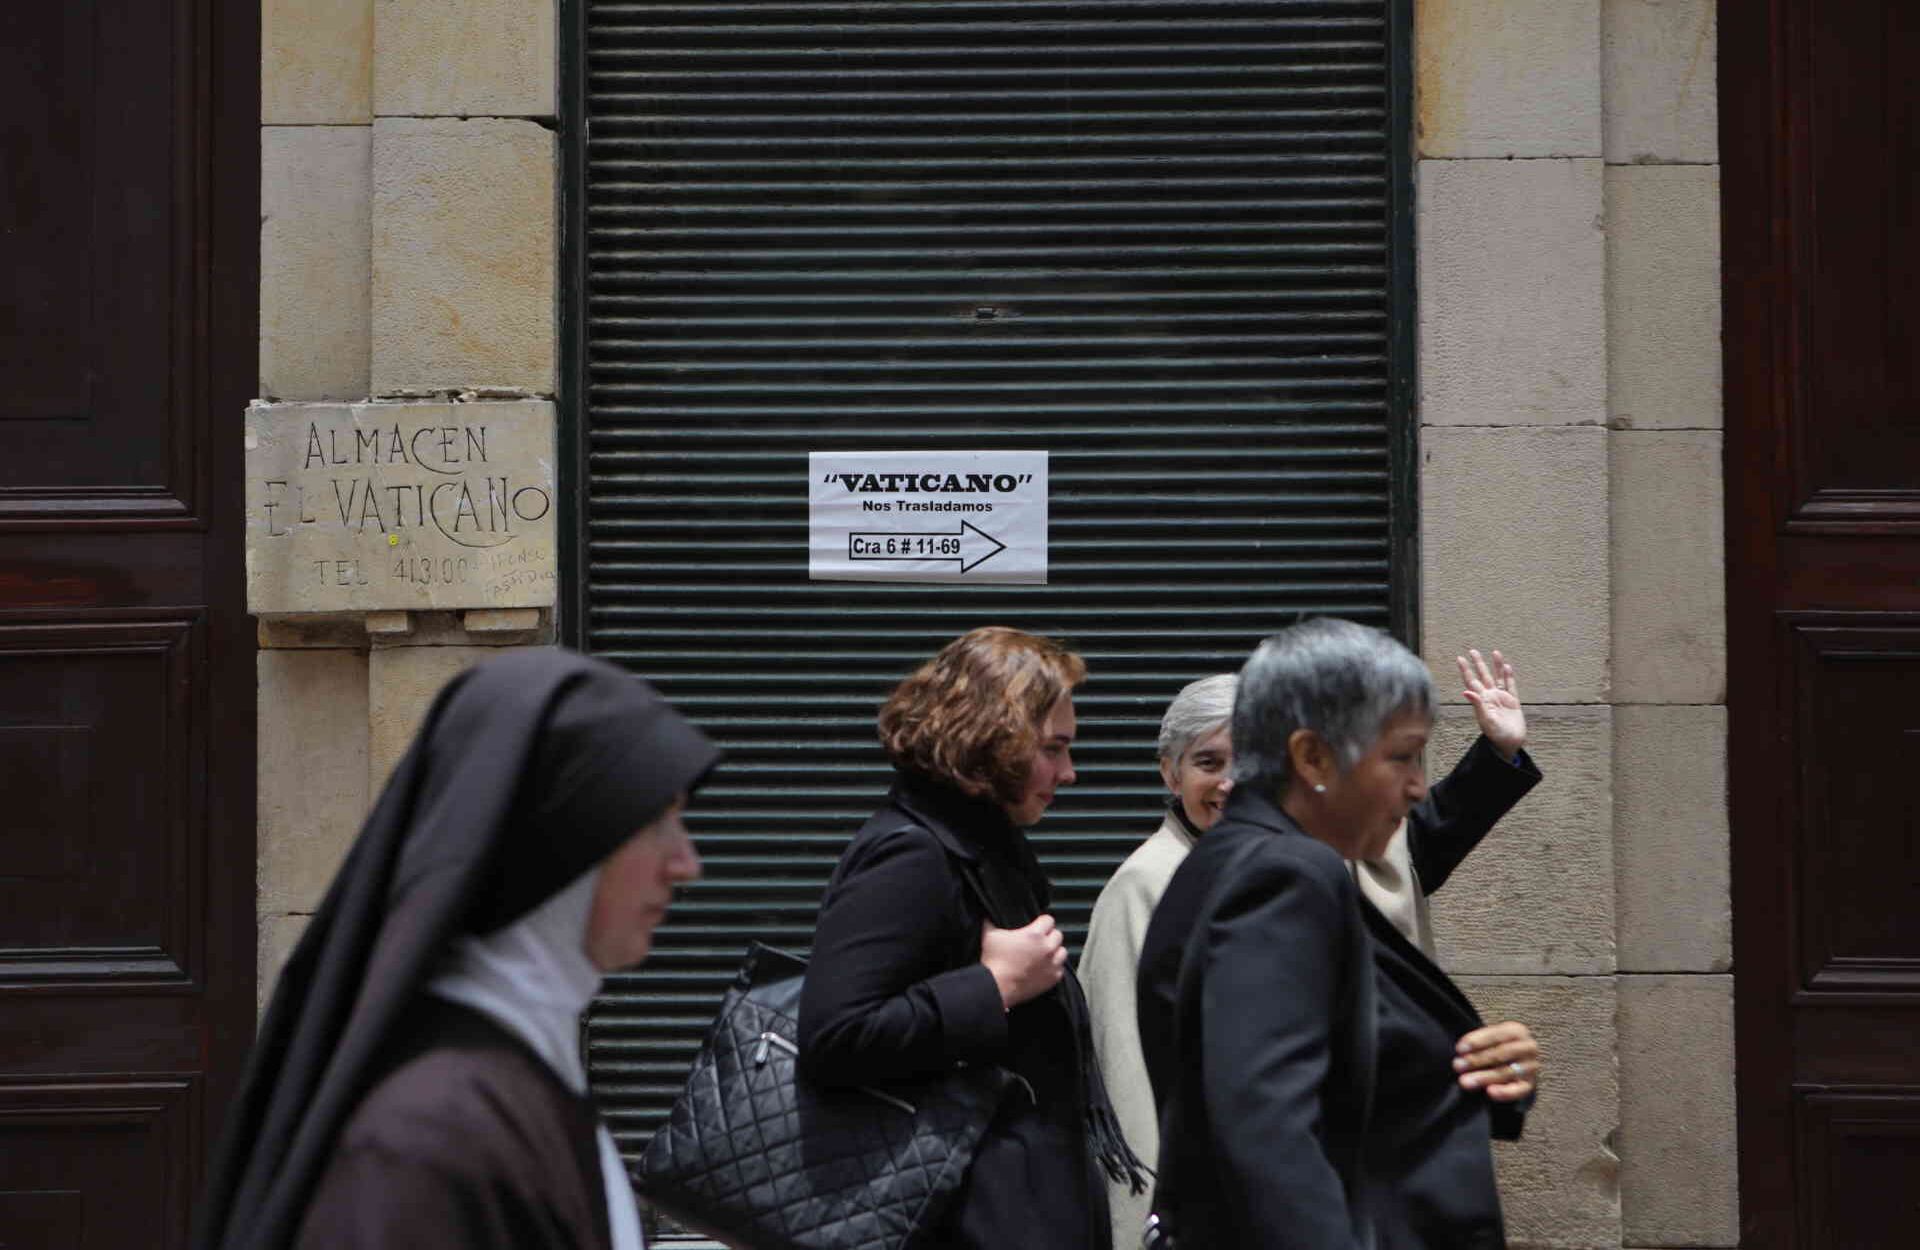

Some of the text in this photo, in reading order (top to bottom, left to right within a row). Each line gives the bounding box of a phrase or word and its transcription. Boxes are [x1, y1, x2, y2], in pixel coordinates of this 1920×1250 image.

[304, 421, 489, 475] ALMACEN
[263, 476, 550, 549] EL VATICANO
[862, 500, 993, 512] Nos Trasladamos
[853, 538, 961, 555] Cra 6 # 11-69
[312, 559, 370, 586] TEL
